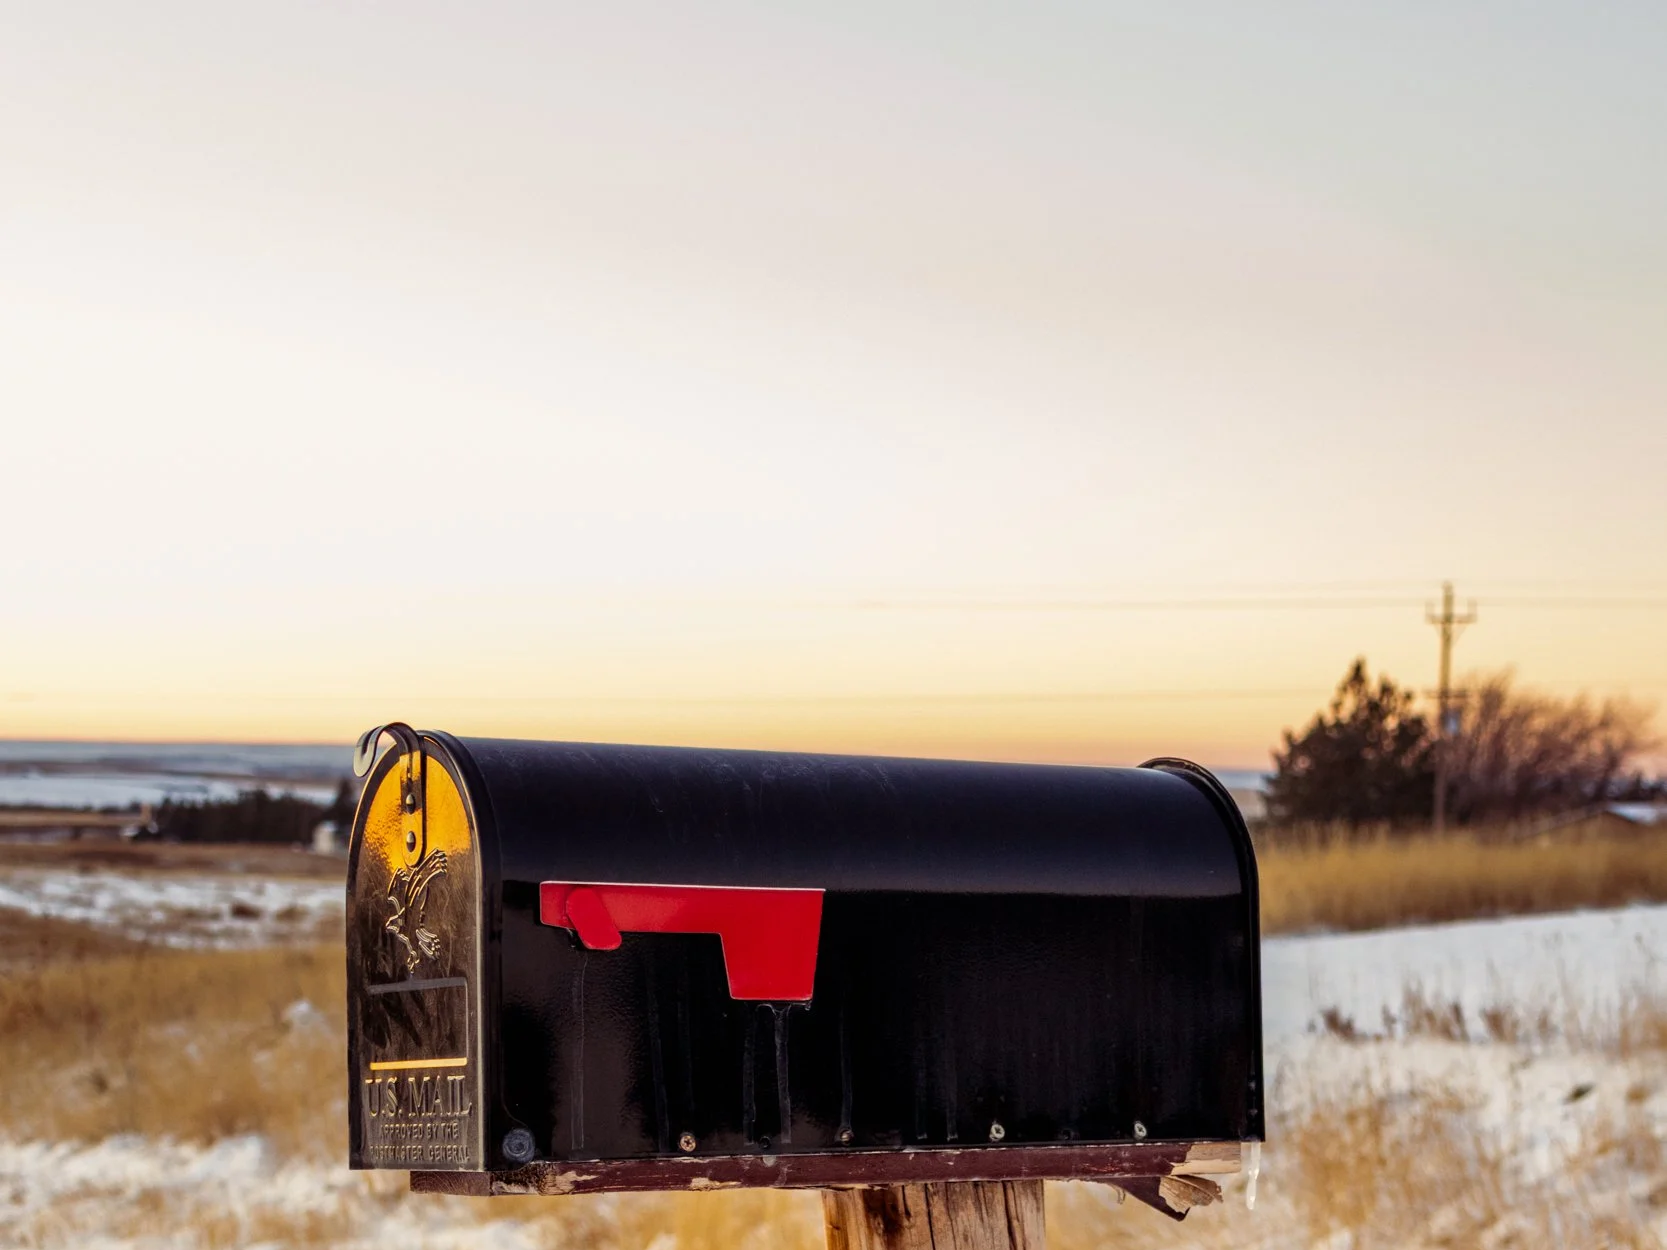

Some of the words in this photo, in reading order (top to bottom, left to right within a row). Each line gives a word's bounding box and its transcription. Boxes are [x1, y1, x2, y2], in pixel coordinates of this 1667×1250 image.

[364, 1076, 403, 1117] U.S.
[408, 1075, 472, 1117] MAIL
[380, 1123, 424, 1139] APPROVED
[427, 1123, 440, 1139] BY
[441, 1122, 459, 1139] THE
[369, 1145, 424, 1161] POSTMASTER
[429, 1144, 471, 1162] GENERAL
